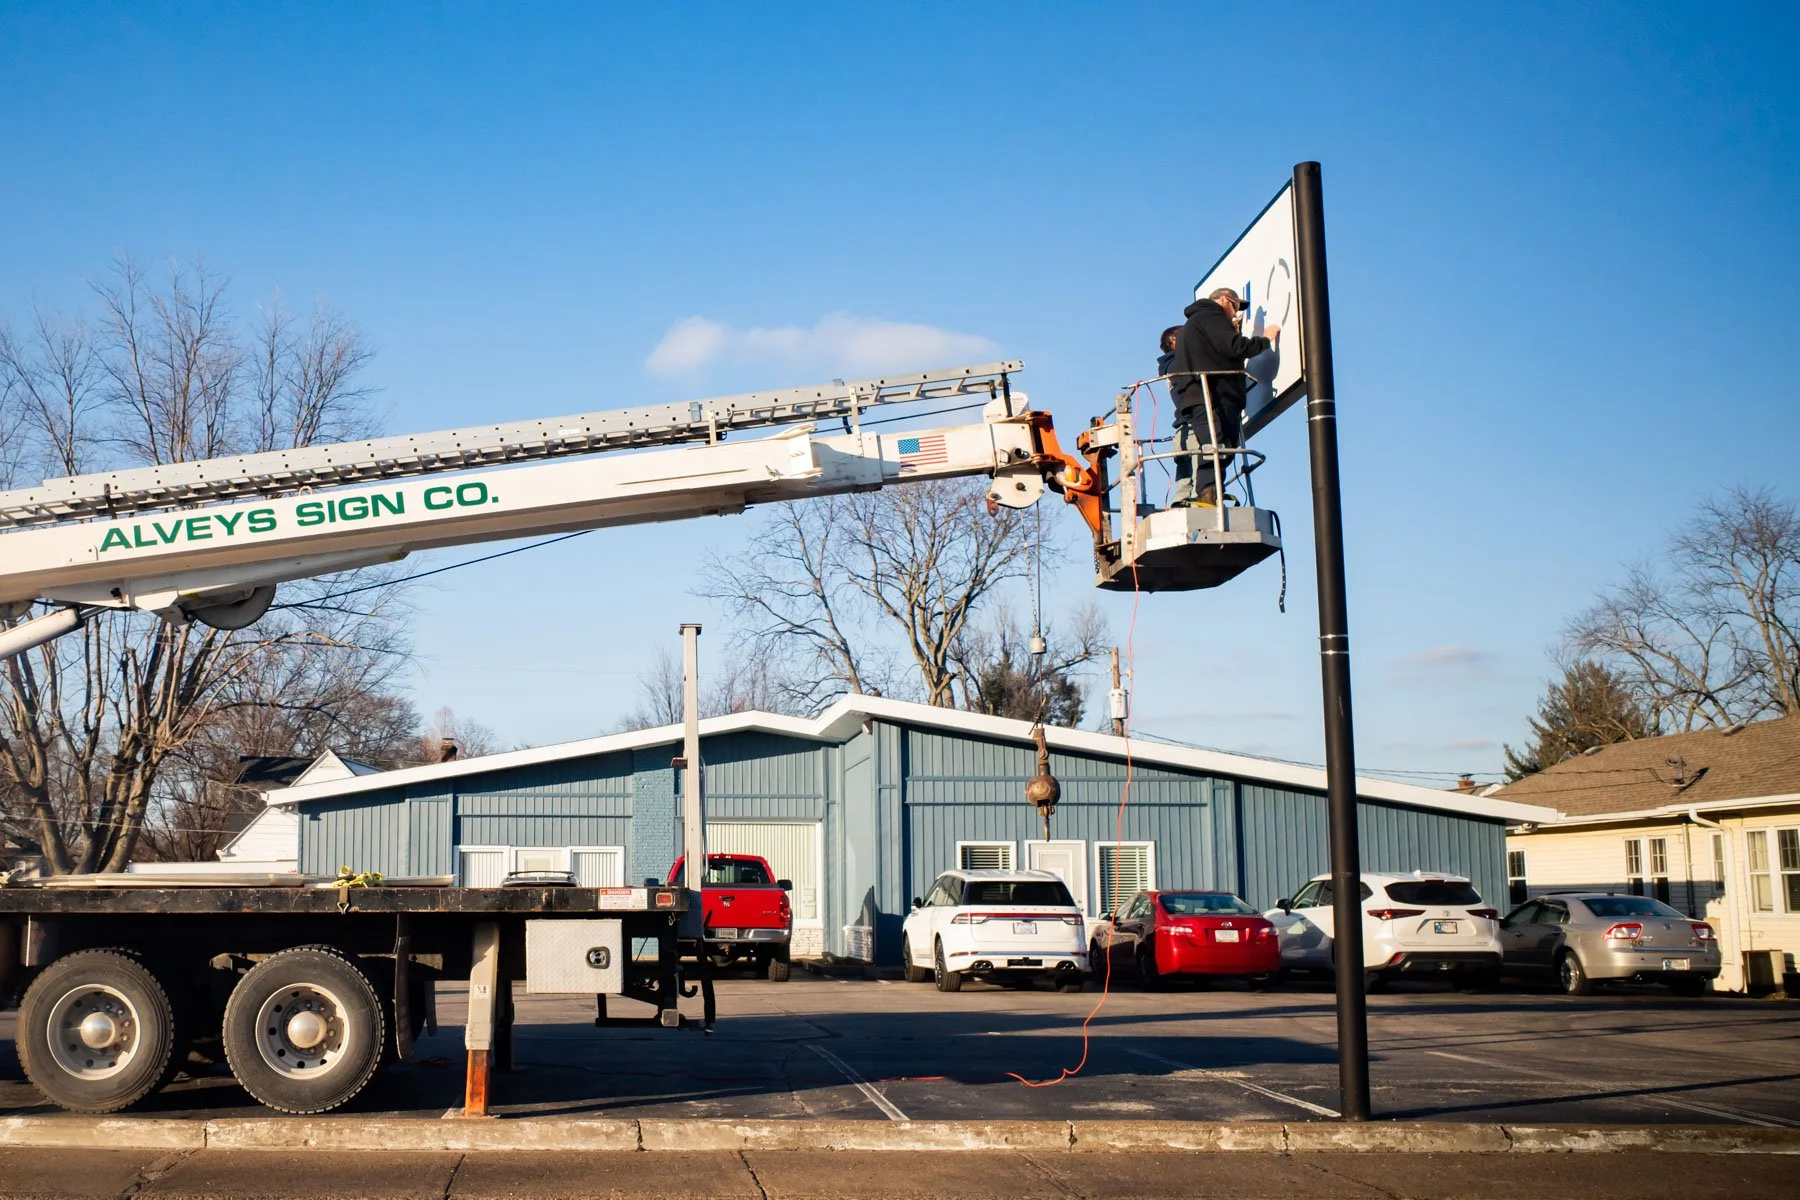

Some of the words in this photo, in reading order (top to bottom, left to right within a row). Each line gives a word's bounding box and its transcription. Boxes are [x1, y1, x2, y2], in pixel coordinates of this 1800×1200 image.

[99, 507, 278, 553] ALVEYS
[294, 490, 406, 527] SIGN
[422, 481, 500, 511] CO.
